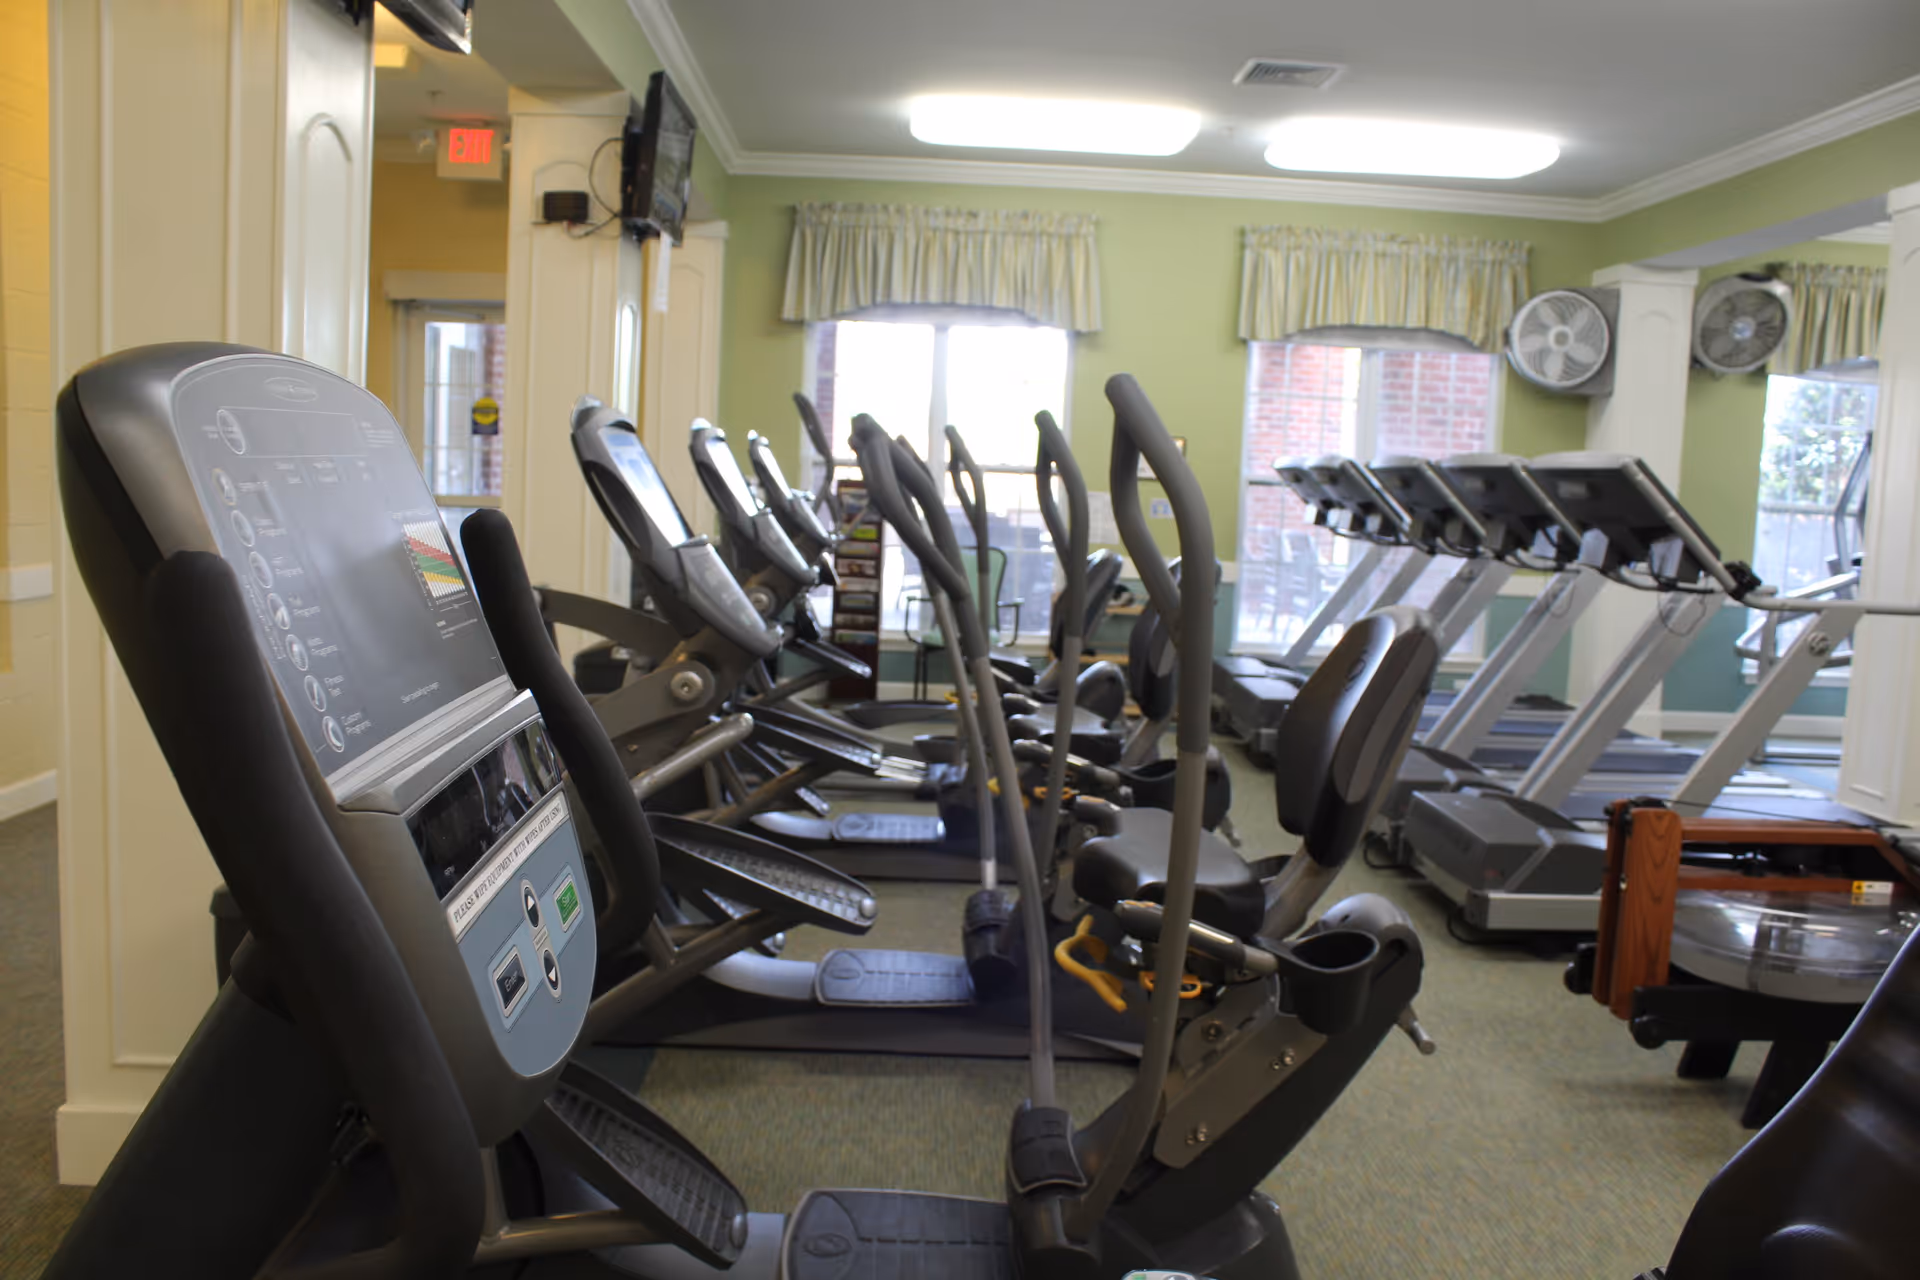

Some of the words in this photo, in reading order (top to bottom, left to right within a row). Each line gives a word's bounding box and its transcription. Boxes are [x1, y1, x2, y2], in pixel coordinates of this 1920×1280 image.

[449, 128, 494, 163] EXIT
[453, 894, 475, 923] PLEASE
[473, 882, 489, 900] WIPE
[487, 852, 515, 884] EQUIPMENT
[513, 840, 526, 858] WITH
[525, 827, 538, 846] WIPES
[537, 813, 551, 833] AFTER
